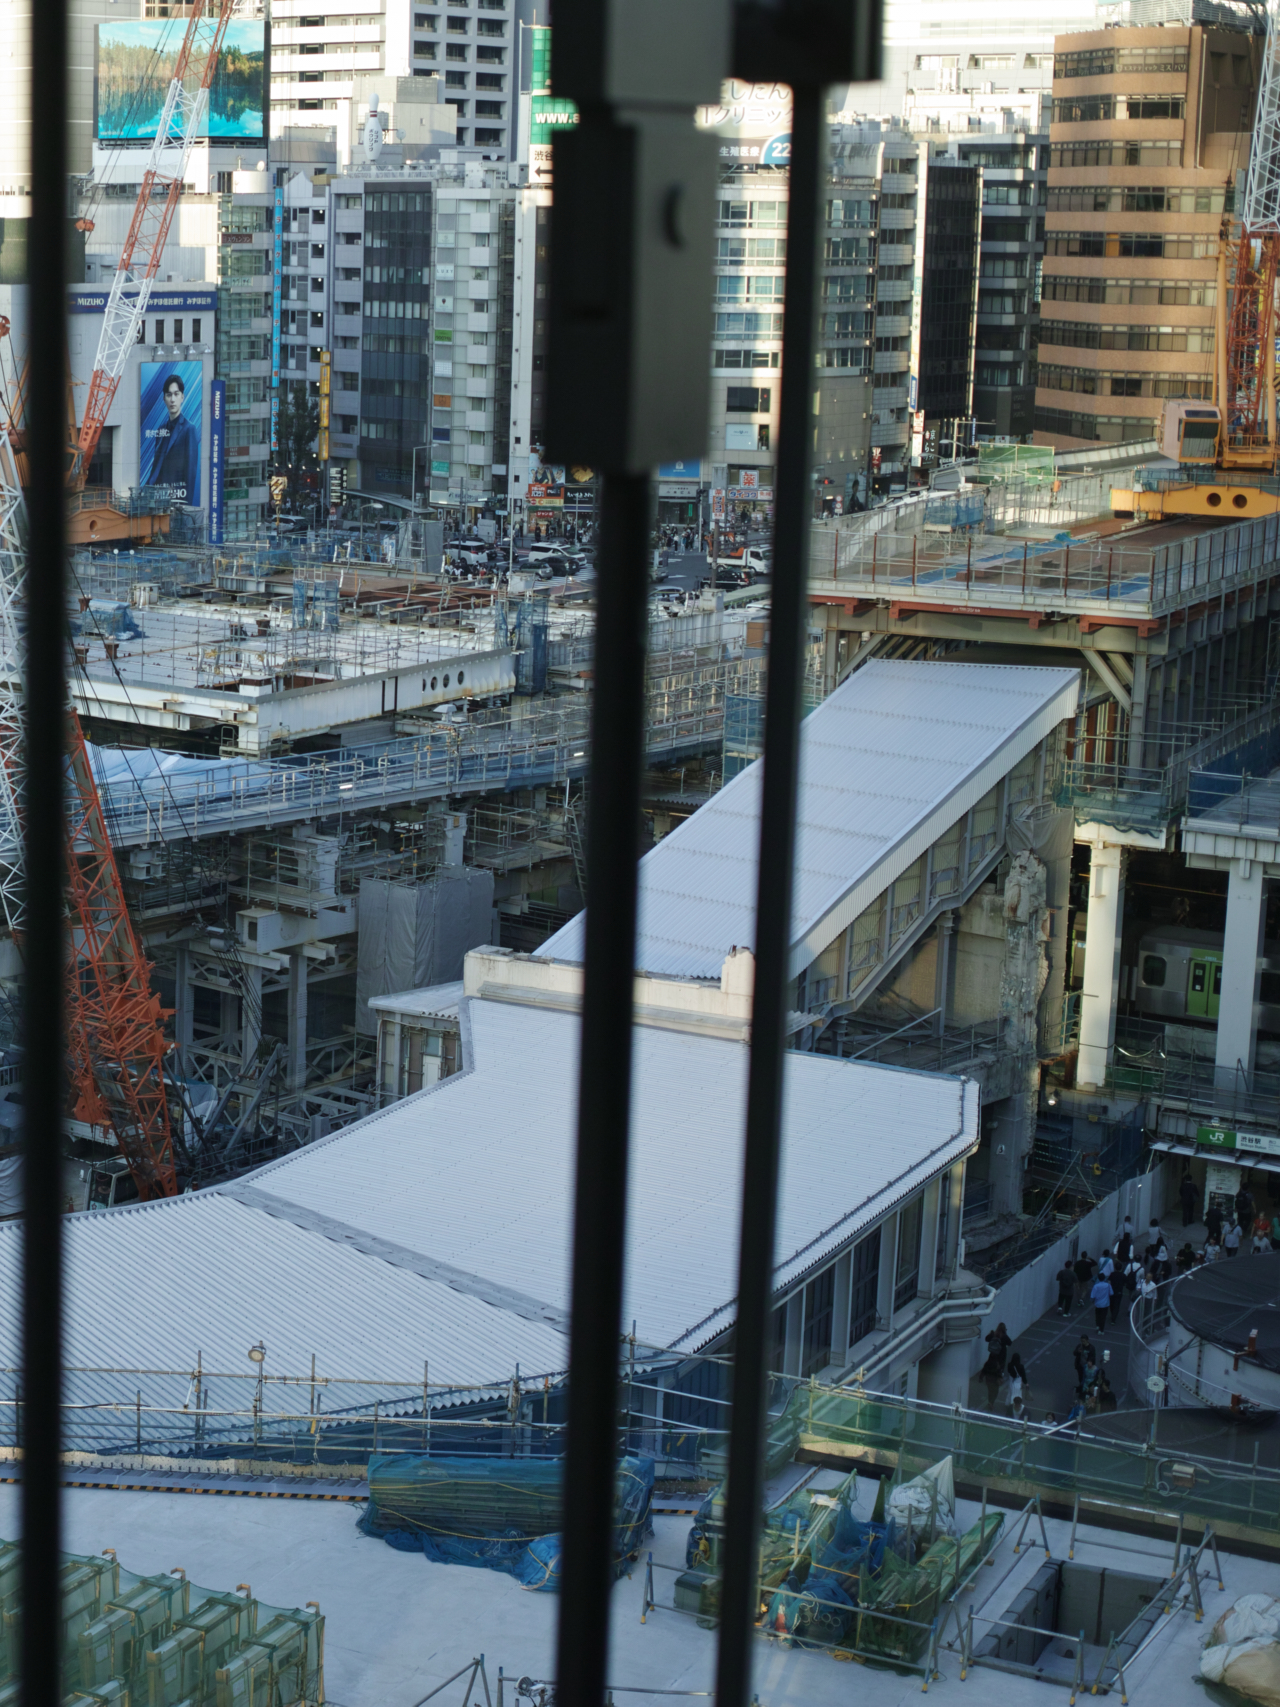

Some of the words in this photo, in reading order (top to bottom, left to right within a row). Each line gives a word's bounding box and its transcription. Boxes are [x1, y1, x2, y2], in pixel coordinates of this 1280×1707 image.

[77, 298, 105, 306] MIZUHO
[1209, 1132, 1225, 1141] JR
[1240, 1135, 1261, 1145] 渋谷駅
